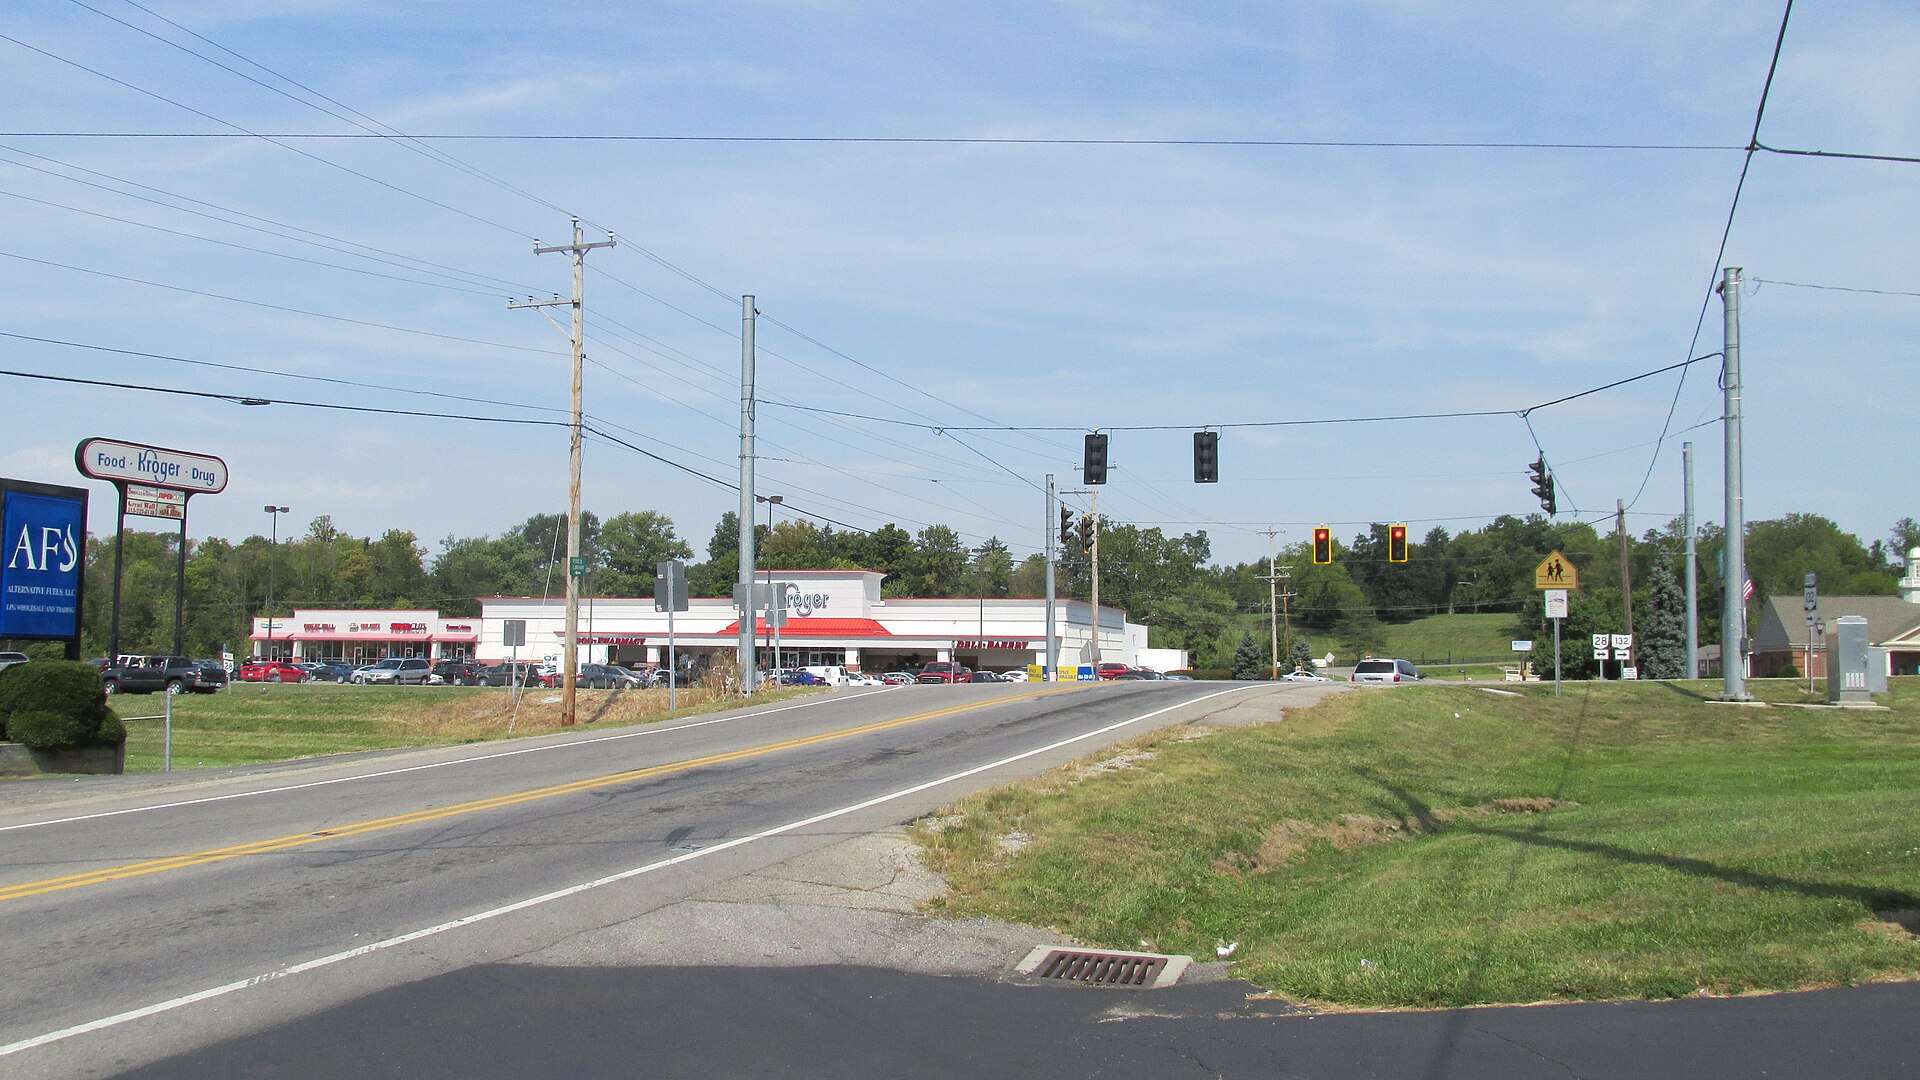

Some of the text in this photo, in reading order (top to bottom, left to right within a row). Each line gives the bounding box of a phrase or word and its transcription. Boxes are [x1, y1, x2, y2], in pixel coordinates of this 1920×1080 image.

[97, 449, 216, 487] Food Kroger Drug
[8, 523, 78, 572] AFS
[1594, 636, 1608, 646] 28
[1614, 637, 1629, 645] 132
